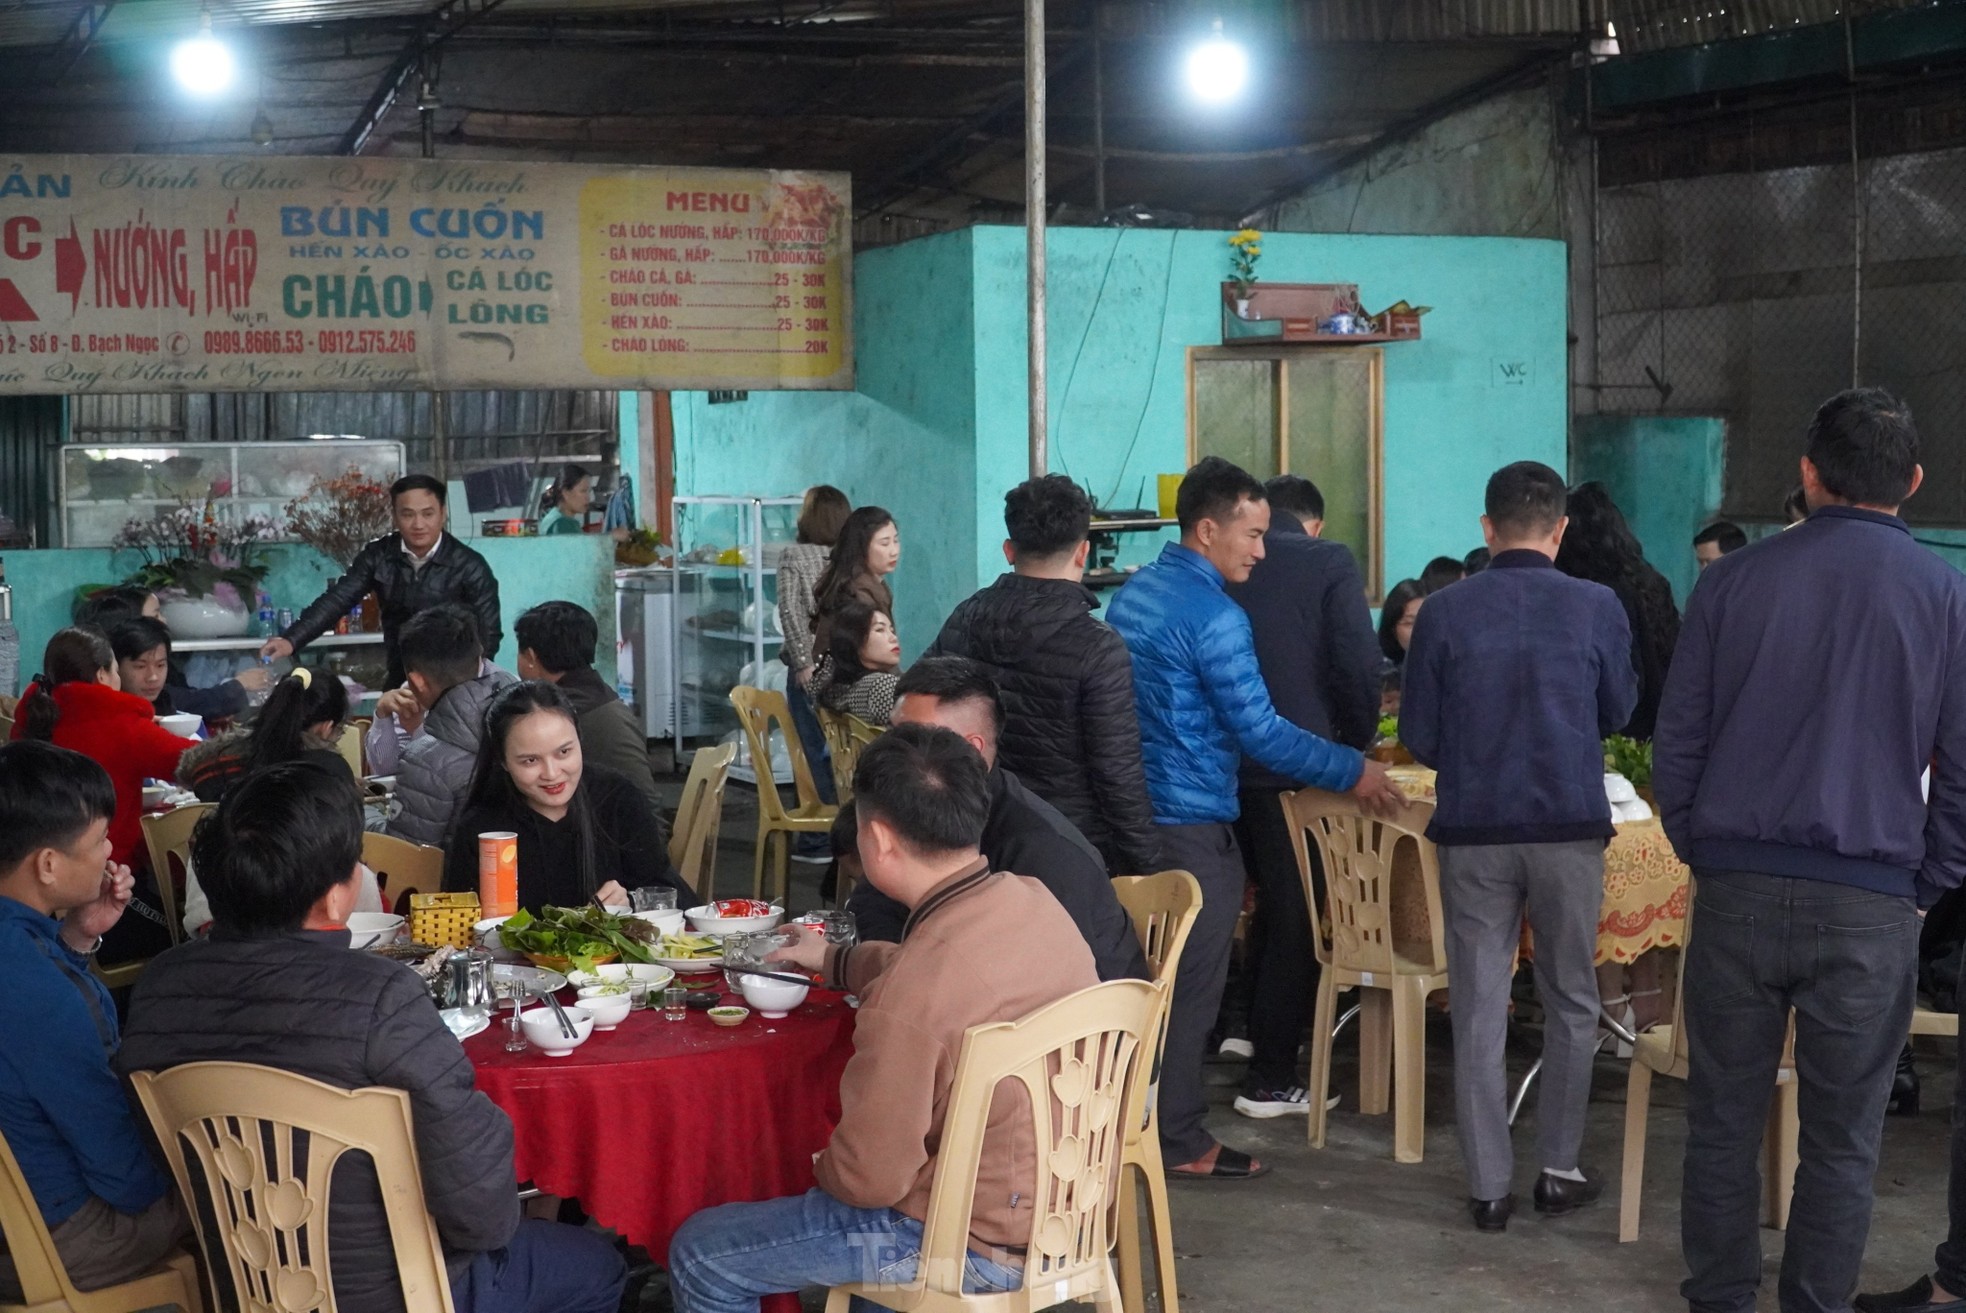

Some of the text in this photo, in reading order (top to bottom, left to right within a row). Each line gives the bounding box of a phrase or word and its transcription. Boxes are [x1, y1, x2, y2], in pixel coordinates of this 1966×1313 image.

[666, 191, 750, 213] MENU
[280, 197, 544, 240] BÚN CUỐN
[609, 221, 627, 238] CÁ
[631, 221, 656, 238] LÓC
[204, 196, 257, 317] HẤP
[289, 241, 342, 258] HẾN
[353, 243, 410, 259] XÀO
[481, 245, 535, 260] XÀO
[610, 245, 628, 261] GÀ
[447, 266, 553, 291] CÁ LÓC
[610, 267, 646, 284] CHÁO
[774, 272, 789, 287] 25
[802, 273, 825, 288] 30K
[282, 265, 412, 319] CHÁO
[775, 295, 790, 309] 25
[803, 296, 827, 310] 30K
[778, 318, 792, 331] 25
[805, 318, 829, 332] 30K
[89, 333, 121, 356] Bạch
[125, 333, 160, 356] Ngọc
[203, 329, 416, 354] 0989.8666.53 0912.575.246
[612, 337, 647, 353] CHÁO
[1500, 362, 1527, 377] WC
